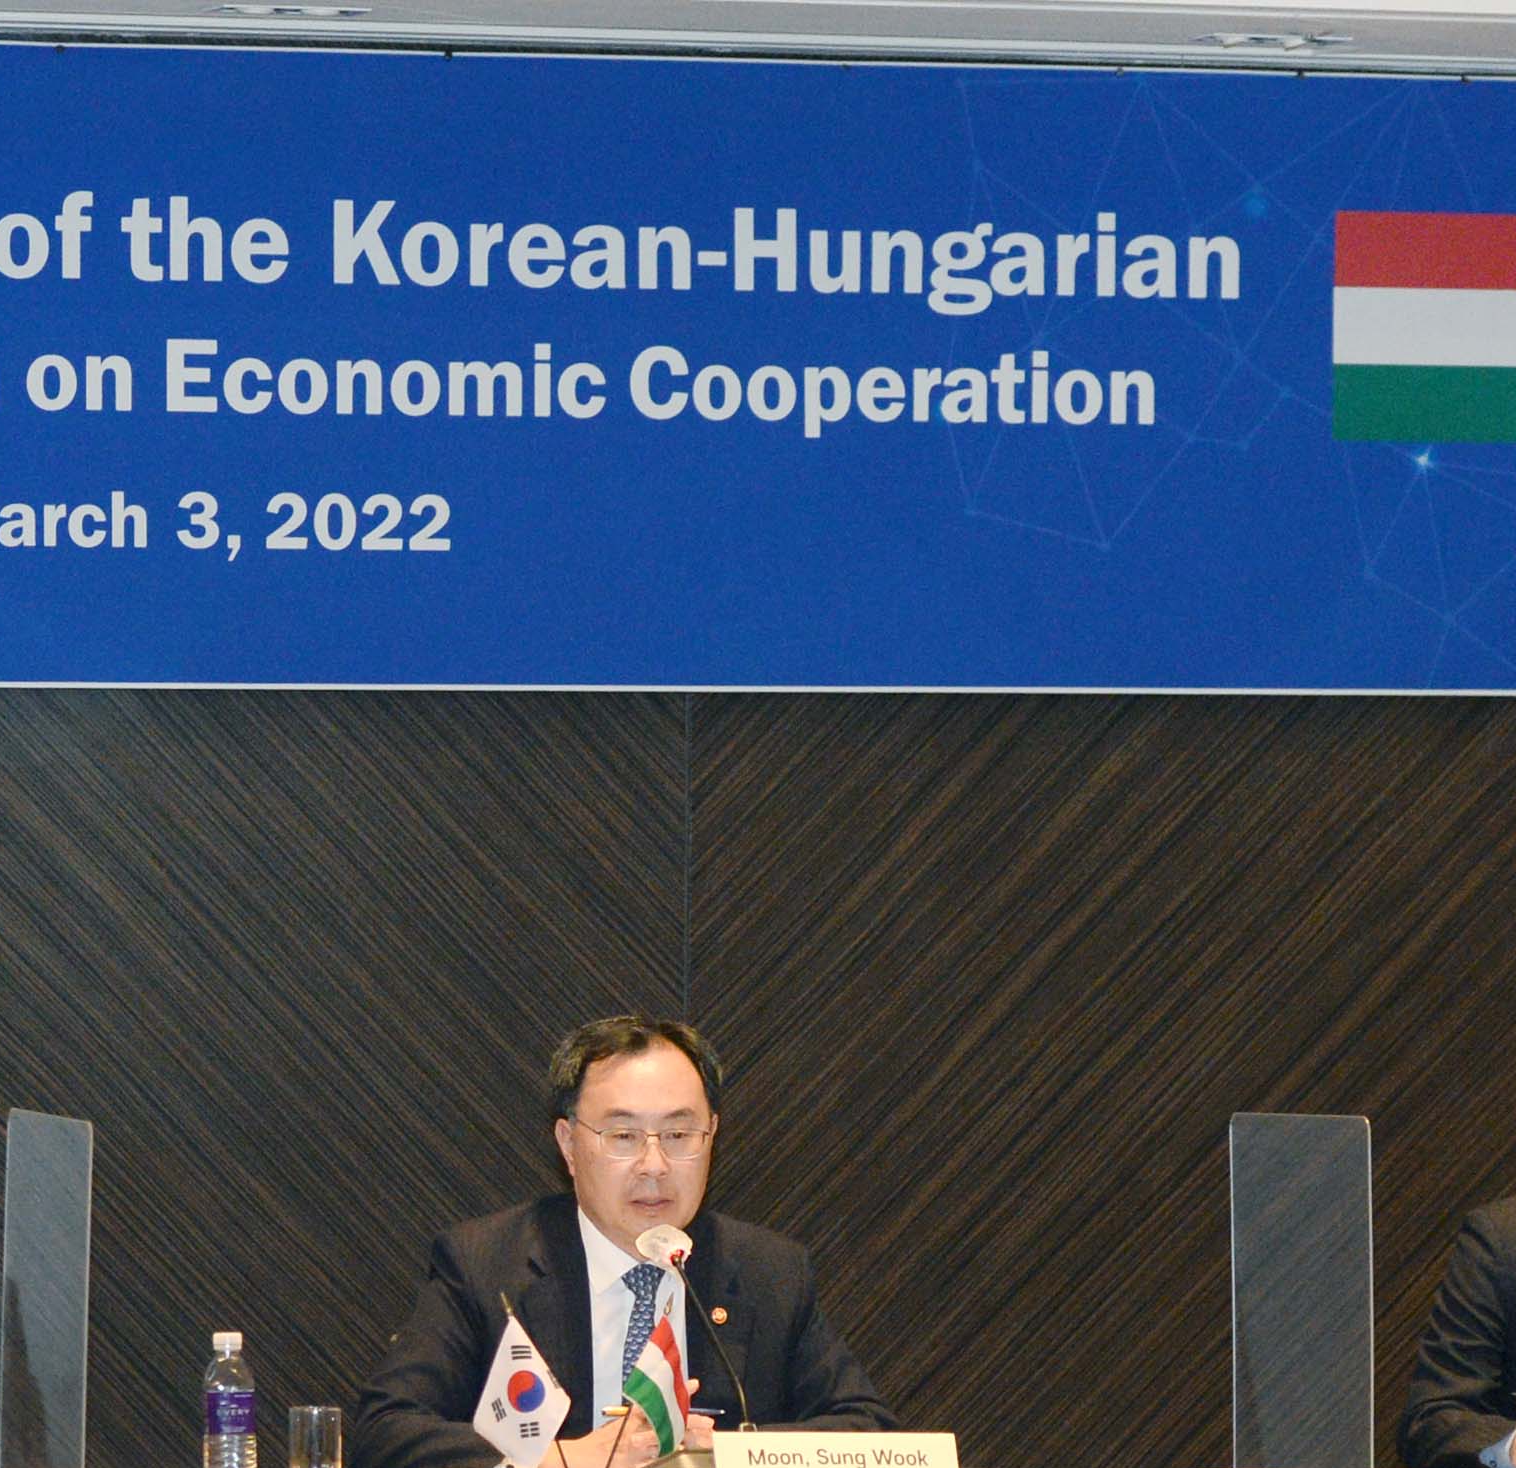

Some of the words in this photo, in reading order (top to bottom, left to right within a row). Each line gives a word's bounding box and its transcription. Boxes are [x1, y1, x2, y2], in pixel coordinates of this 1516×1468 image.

[121, 196, 289, 283] the
[334, 200, 1240, 315] Korean-Hungarian
[26, 355, 132, 411] on
[167, 339, 606, 418] Economic
[630, 344, 1156, 438] Cooperation
[177, 492, 240, 561] 3,
[266, 493, 450, 551] 2022
[748, 1449, 809, 1465] Moon,
[817, 1449, 866, 1468] Sung
[873, 1450, 928, 1465] Wook
